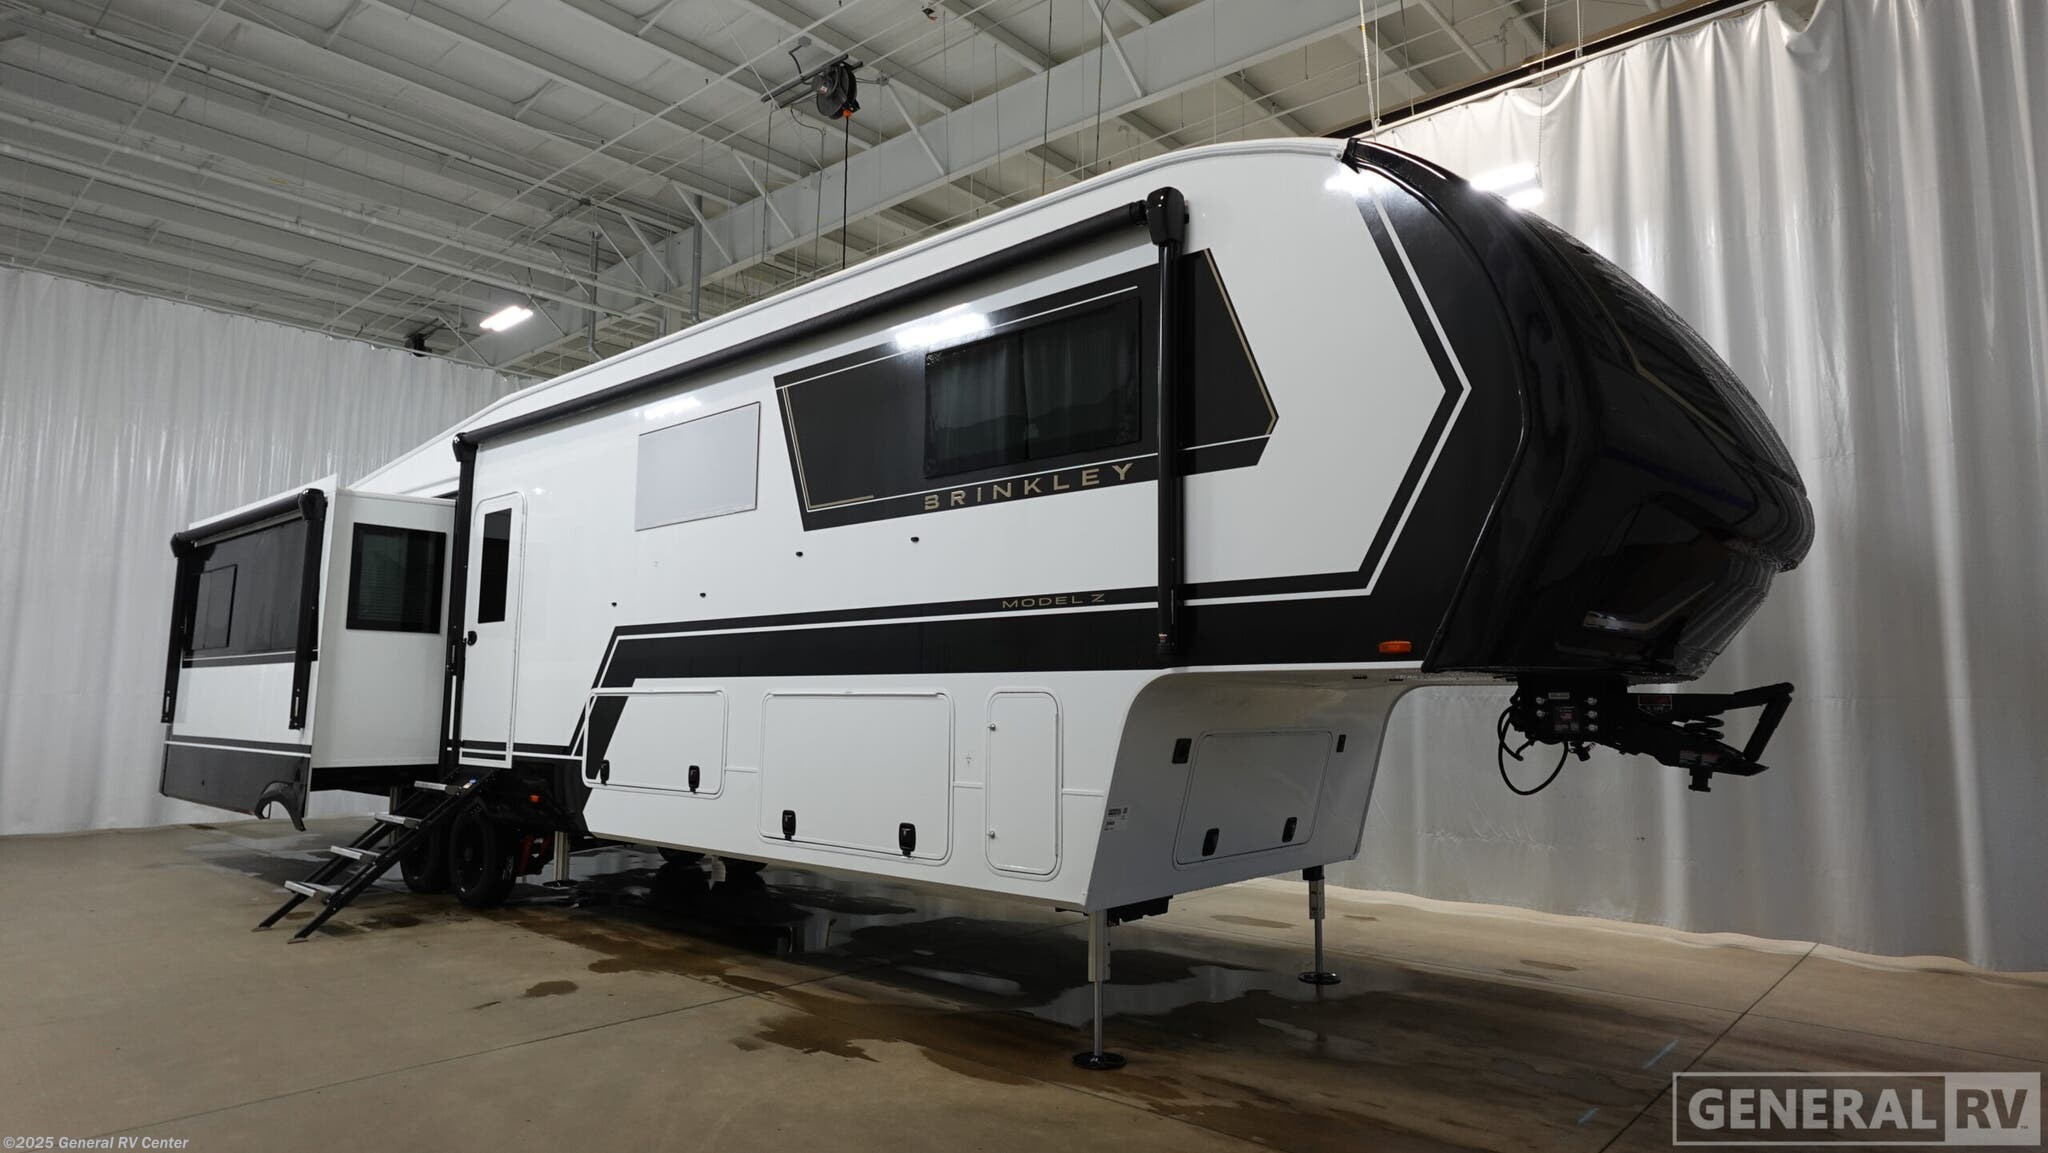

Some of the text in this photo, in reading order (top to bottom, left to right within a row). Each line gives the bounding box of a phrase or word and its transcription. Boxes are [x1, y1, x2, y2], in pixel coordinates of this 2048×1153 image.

[924, 463, 1133, 511] BRINKLEY
[1002, 593, 1106, 609] MODEL Z
